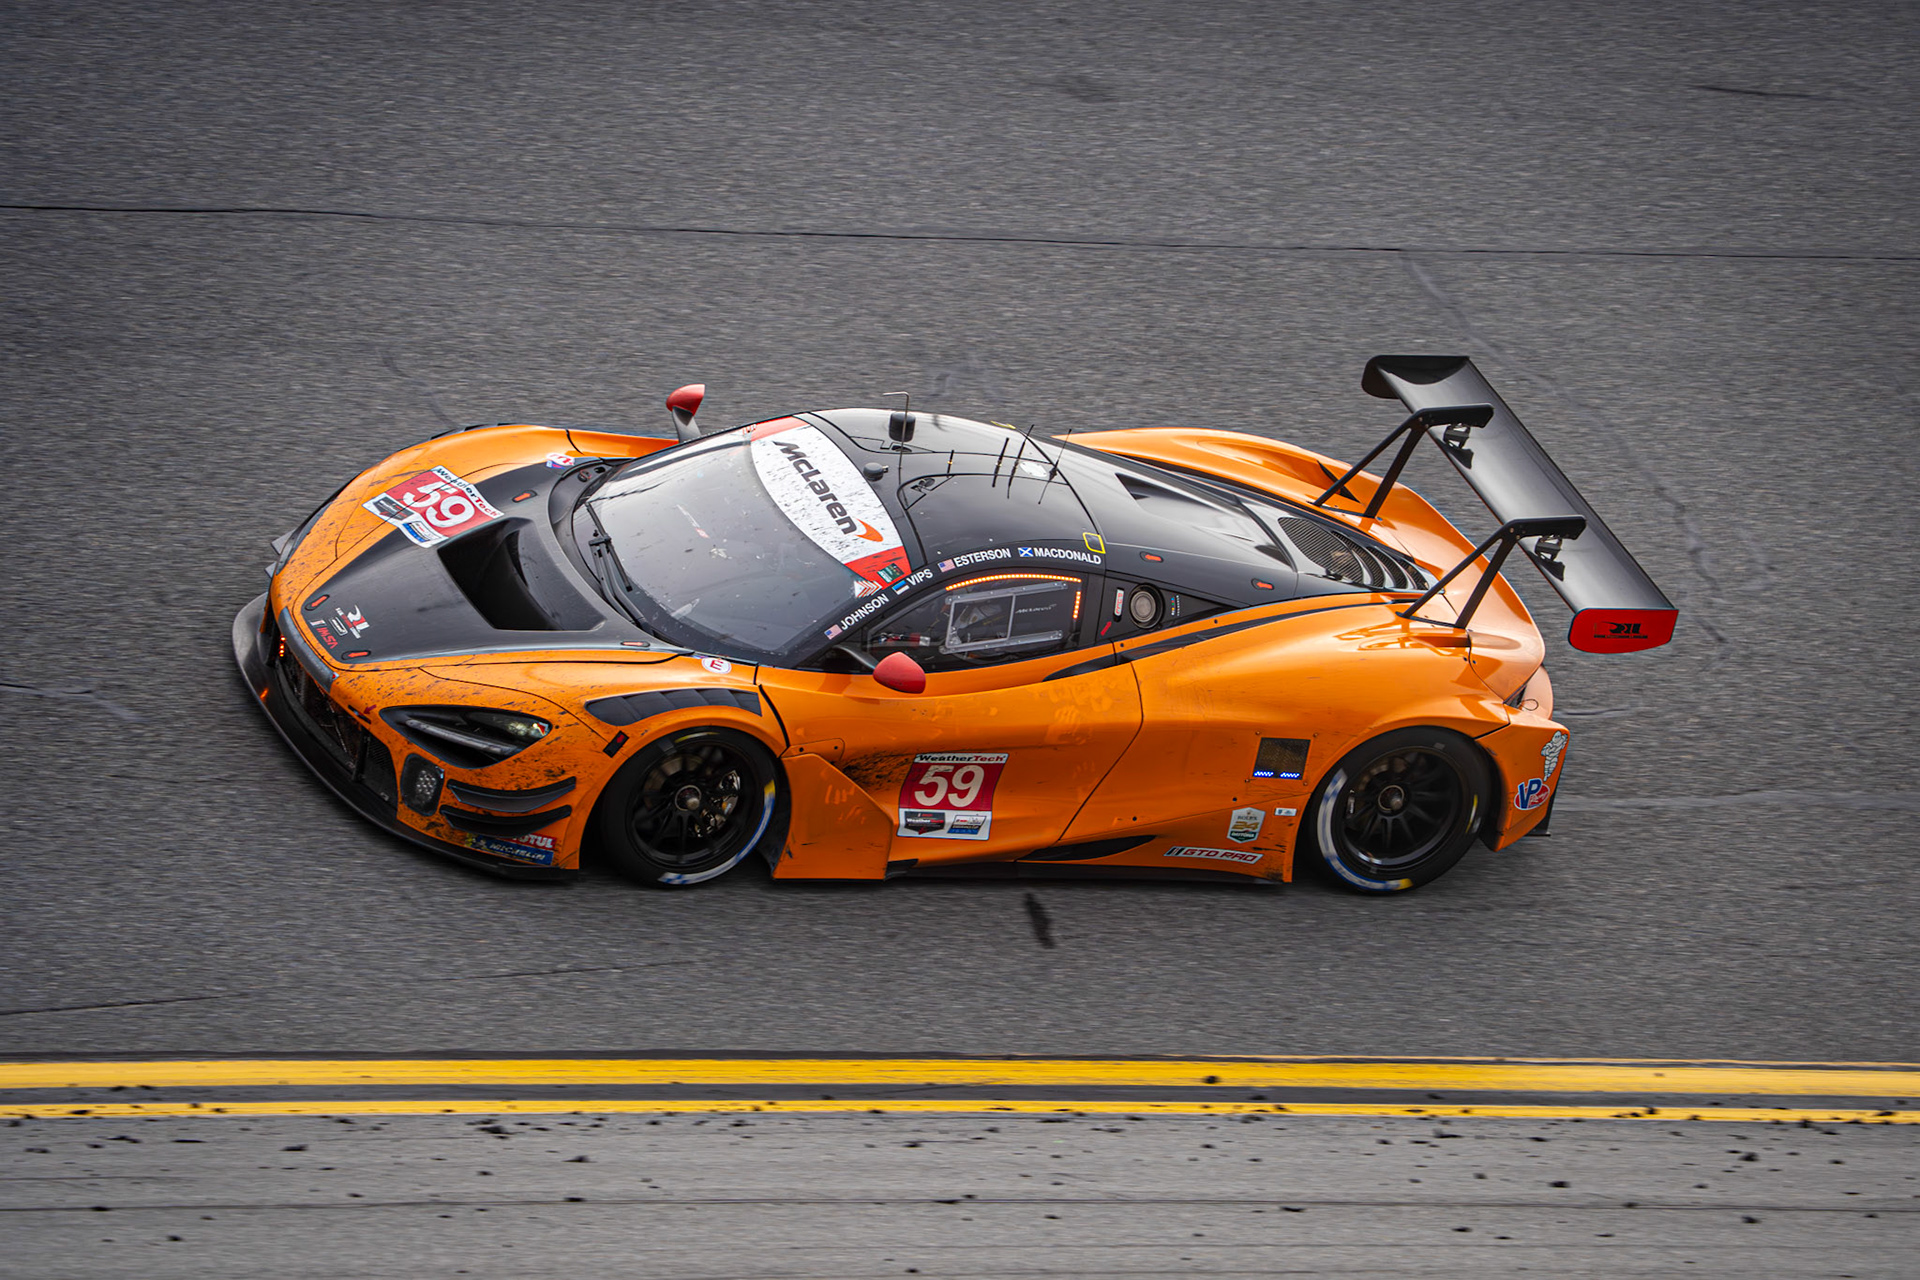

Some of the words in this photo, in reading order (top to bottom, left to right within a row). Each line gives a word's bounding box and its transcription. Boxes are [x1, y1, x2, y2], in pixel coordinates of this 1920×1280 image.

[436, 468, 498, 517] WeatherTech
[772, 440, 857, 535] McLaren
[402, 481, 475, 528] 59
[953, 548, 1011, 567] ESTERSON
[1033, 547, 1102, 565] MACDONALD
[906, 568, 934, 586] VIPS
[840, 593, 889, 630] JOHNSON
[316, 627, 338, 649] IMSA
[914, 765, 985, 808] 59
[1518, 778, 1543, 809] VP
[1231, 821, 1260, 830] 24
[513, 833, 553, 848] OTUL
[489, 843, 546, 860] MICHELIN
[1183, 848, 1218, 857] GTD
